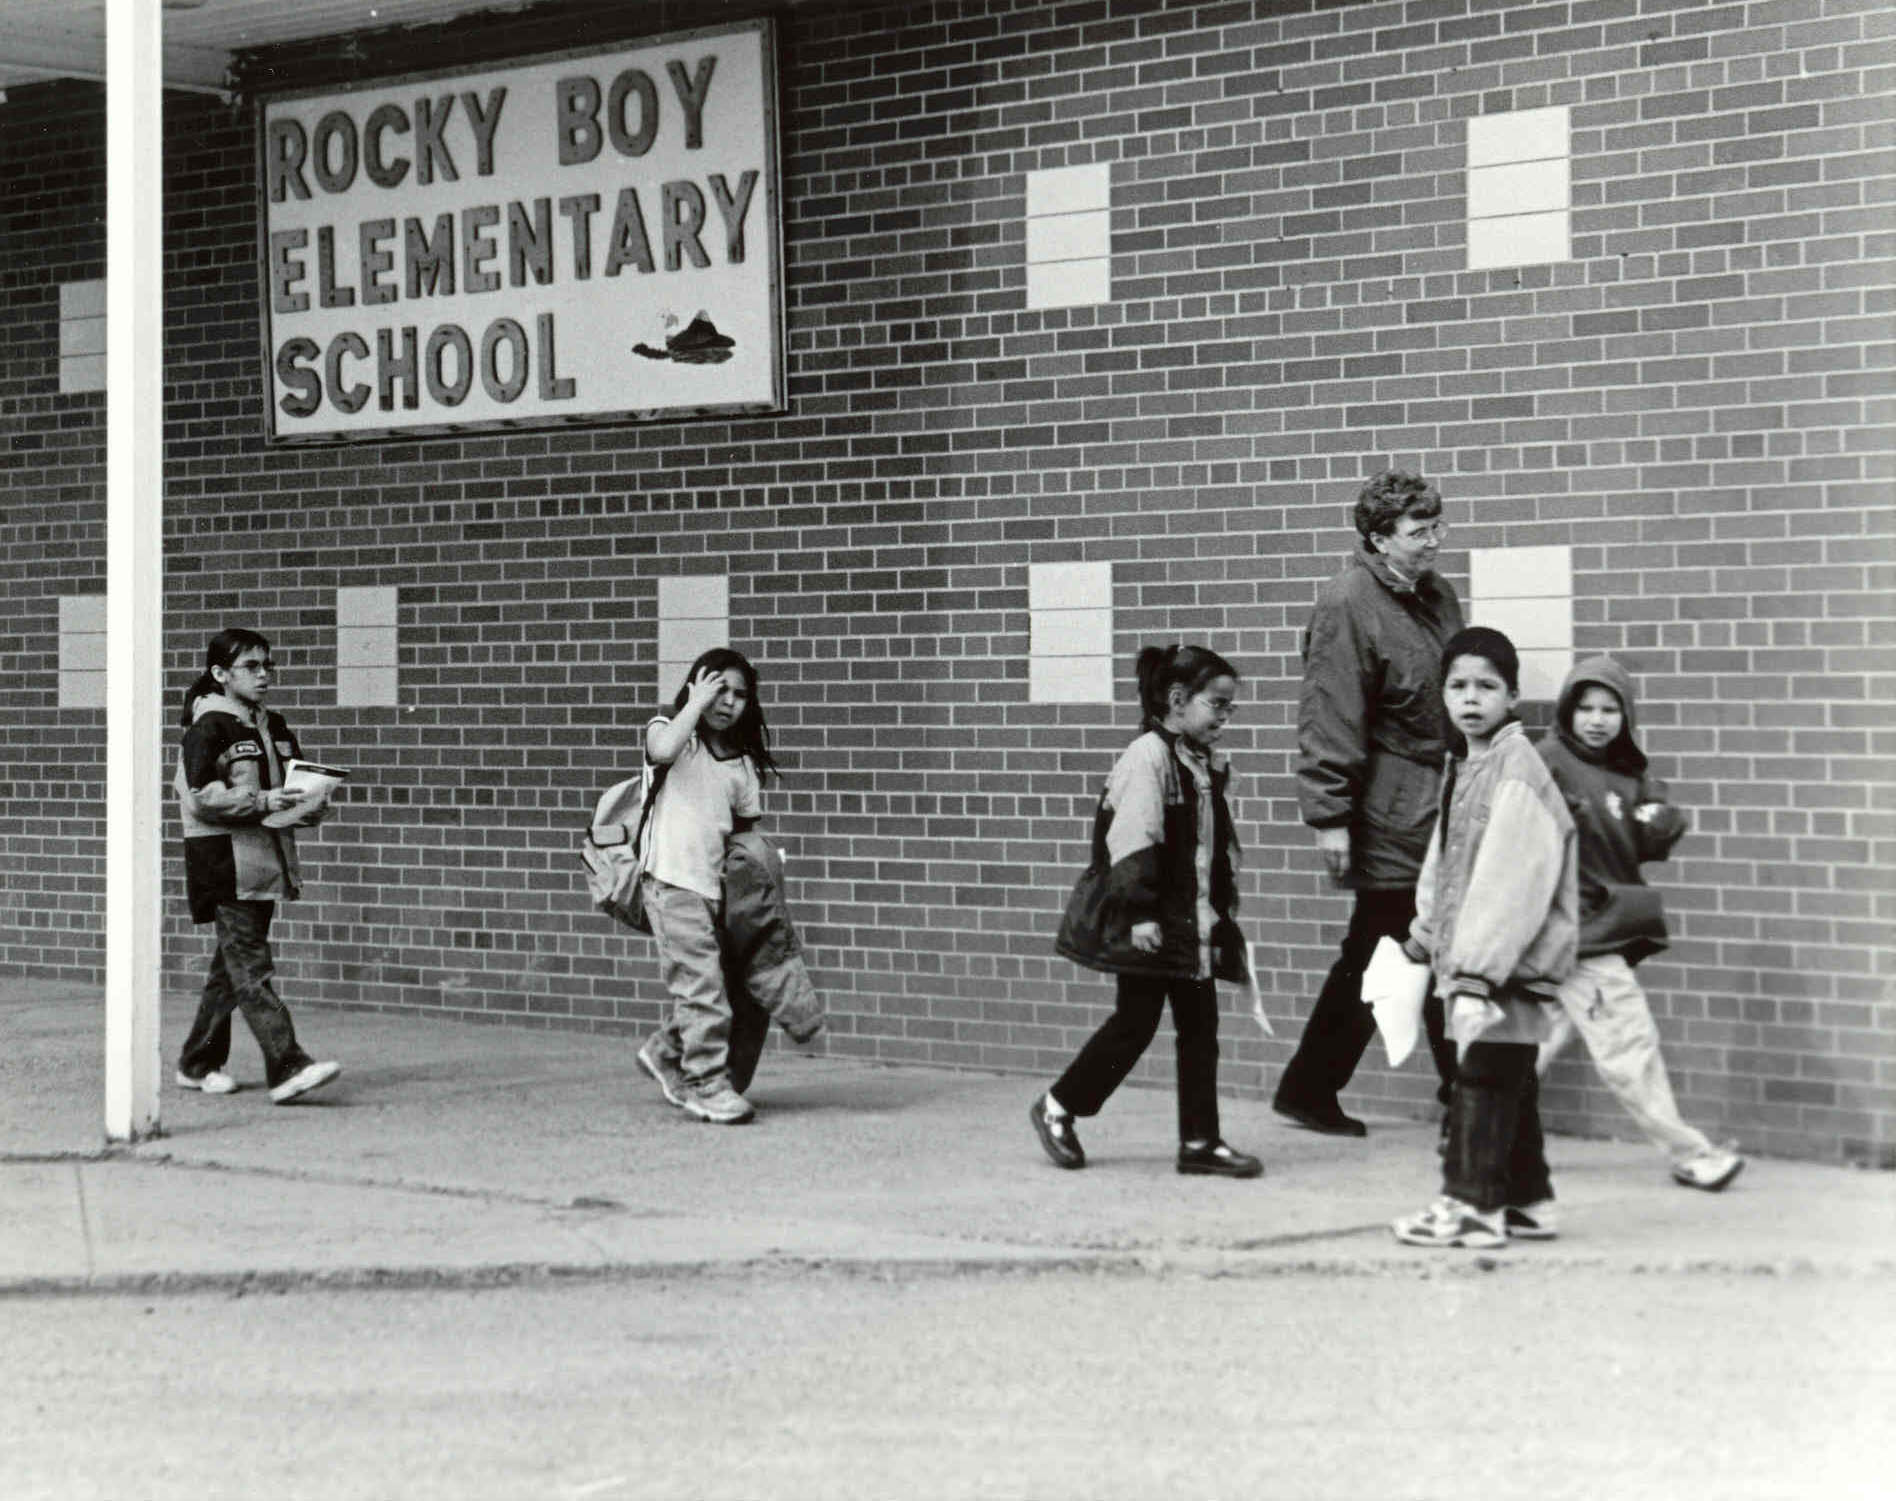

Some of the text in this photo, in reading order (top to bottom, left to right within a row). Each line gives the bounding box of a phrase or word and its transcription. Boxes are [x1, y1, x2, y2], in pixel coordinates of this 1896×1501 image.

[269, 55, 718, 203] ROCKY BOY
[271, 169, 760, 314] ELEMENTARY
[276, 312, 576, 418] SCHOOL
